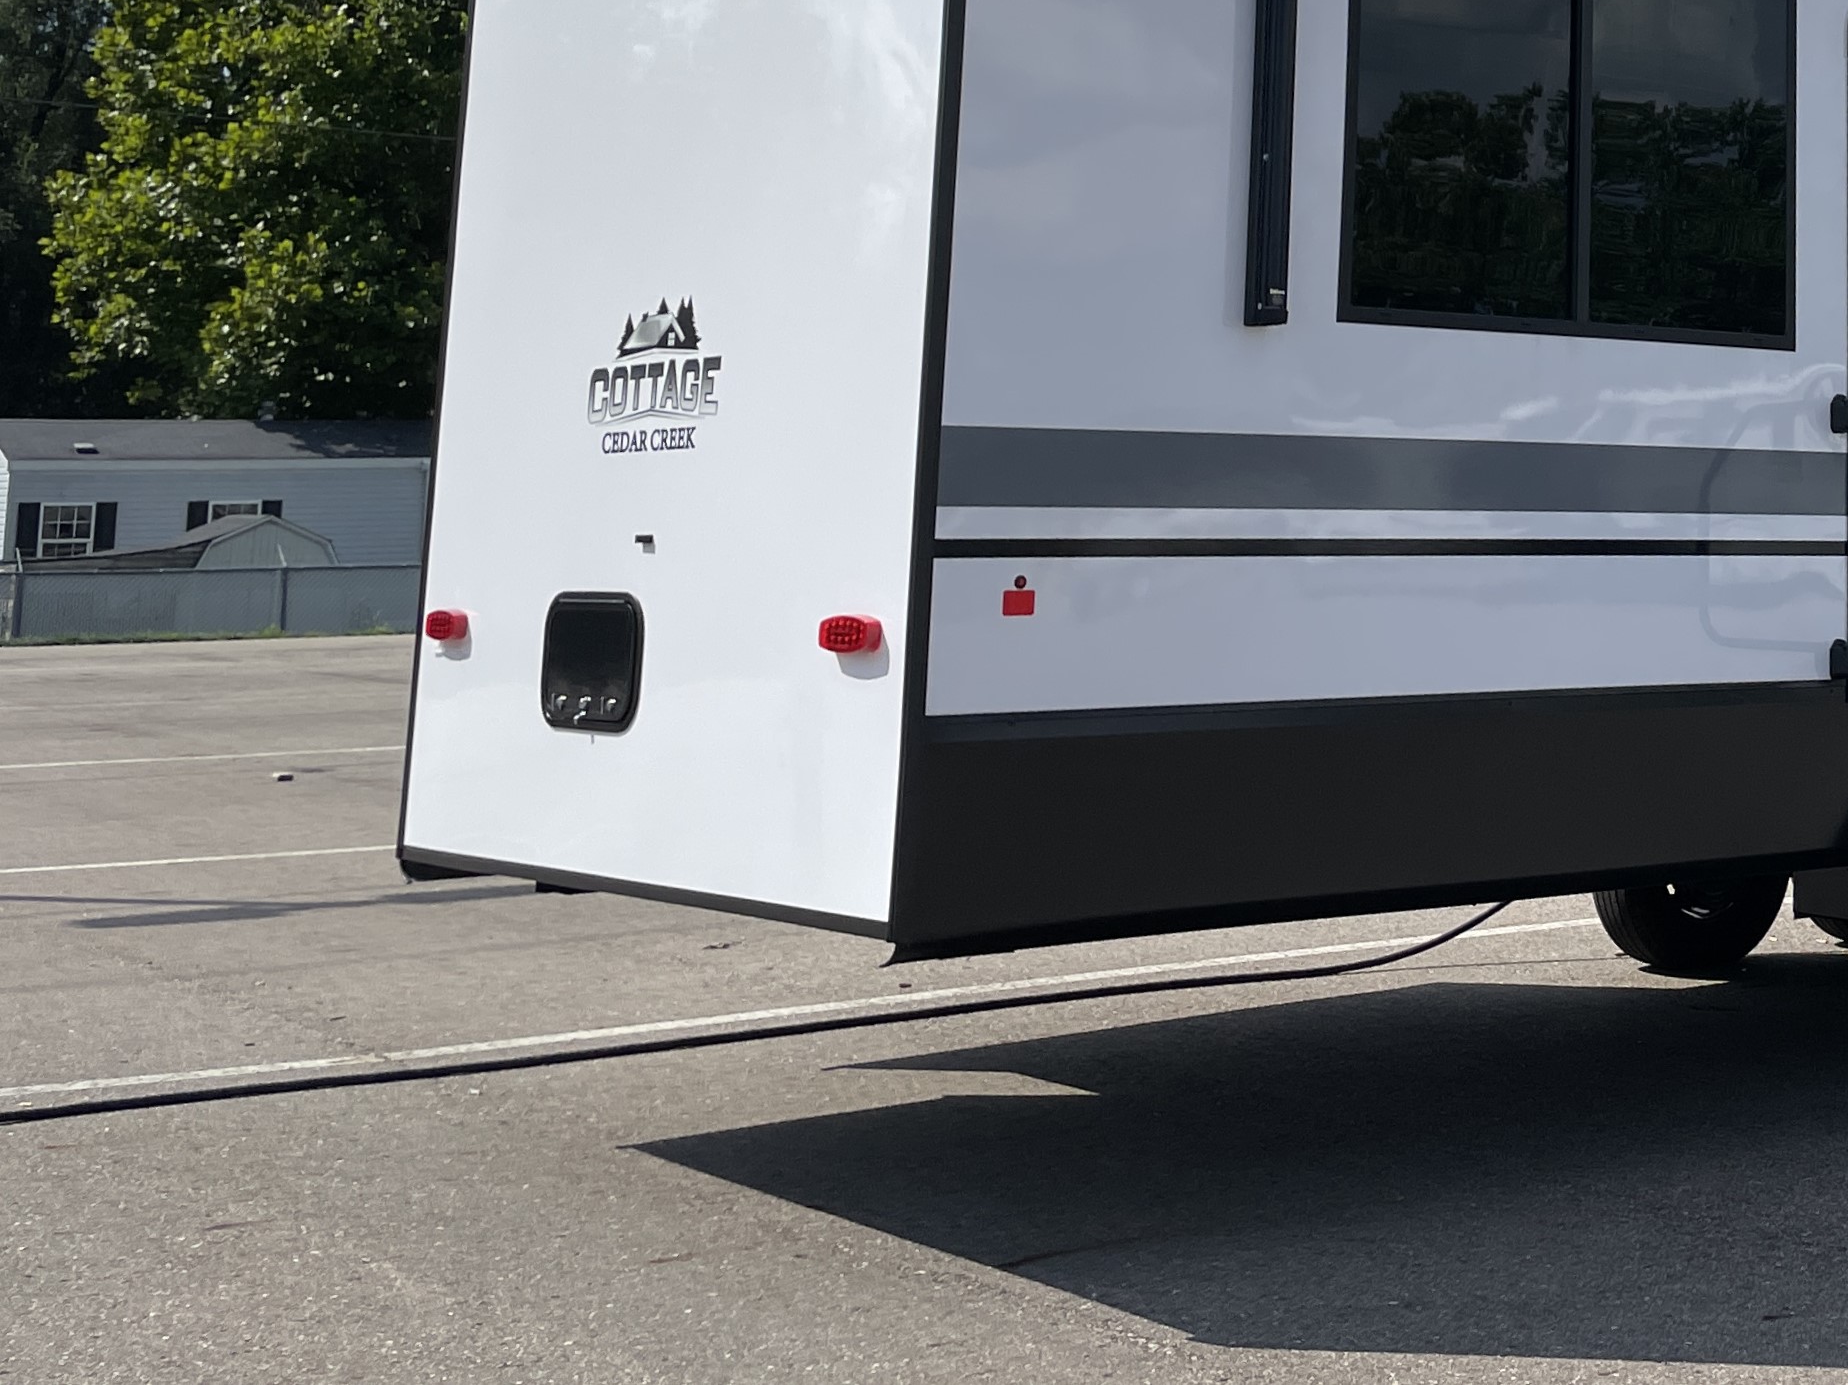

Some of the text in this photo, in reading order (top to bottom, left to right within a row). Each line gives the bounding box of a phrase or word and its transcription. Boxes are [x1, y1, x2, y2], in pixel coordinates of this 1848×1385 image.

[587, 355, 722, 425] COTTAGE
[601, 426, 696, 454] CEDAR CREEK
